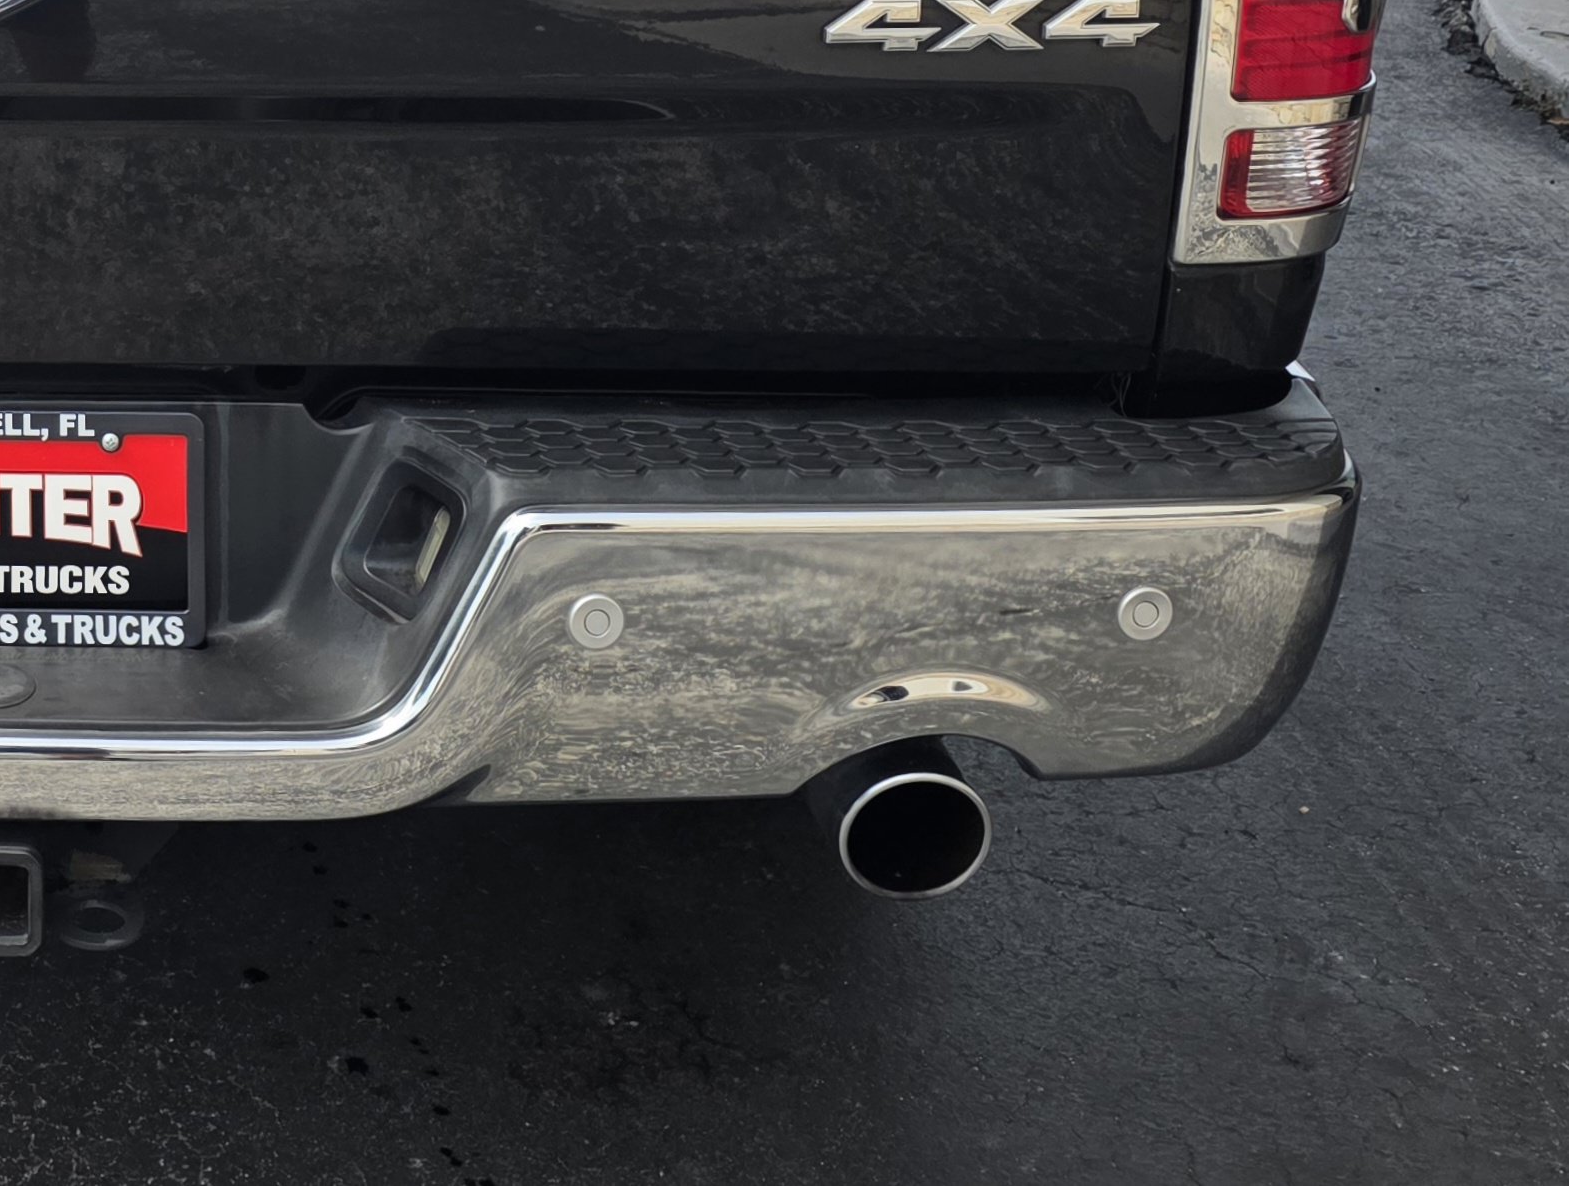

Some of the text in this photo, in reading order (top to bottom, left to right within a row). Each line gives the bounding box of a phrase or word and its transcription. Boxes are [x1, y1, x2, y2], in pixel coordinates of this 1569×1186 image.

[59, 414, 95, 436] FL
[24, 615, 48, 644] &
[51, 614, 185, 646] TRUCKS
